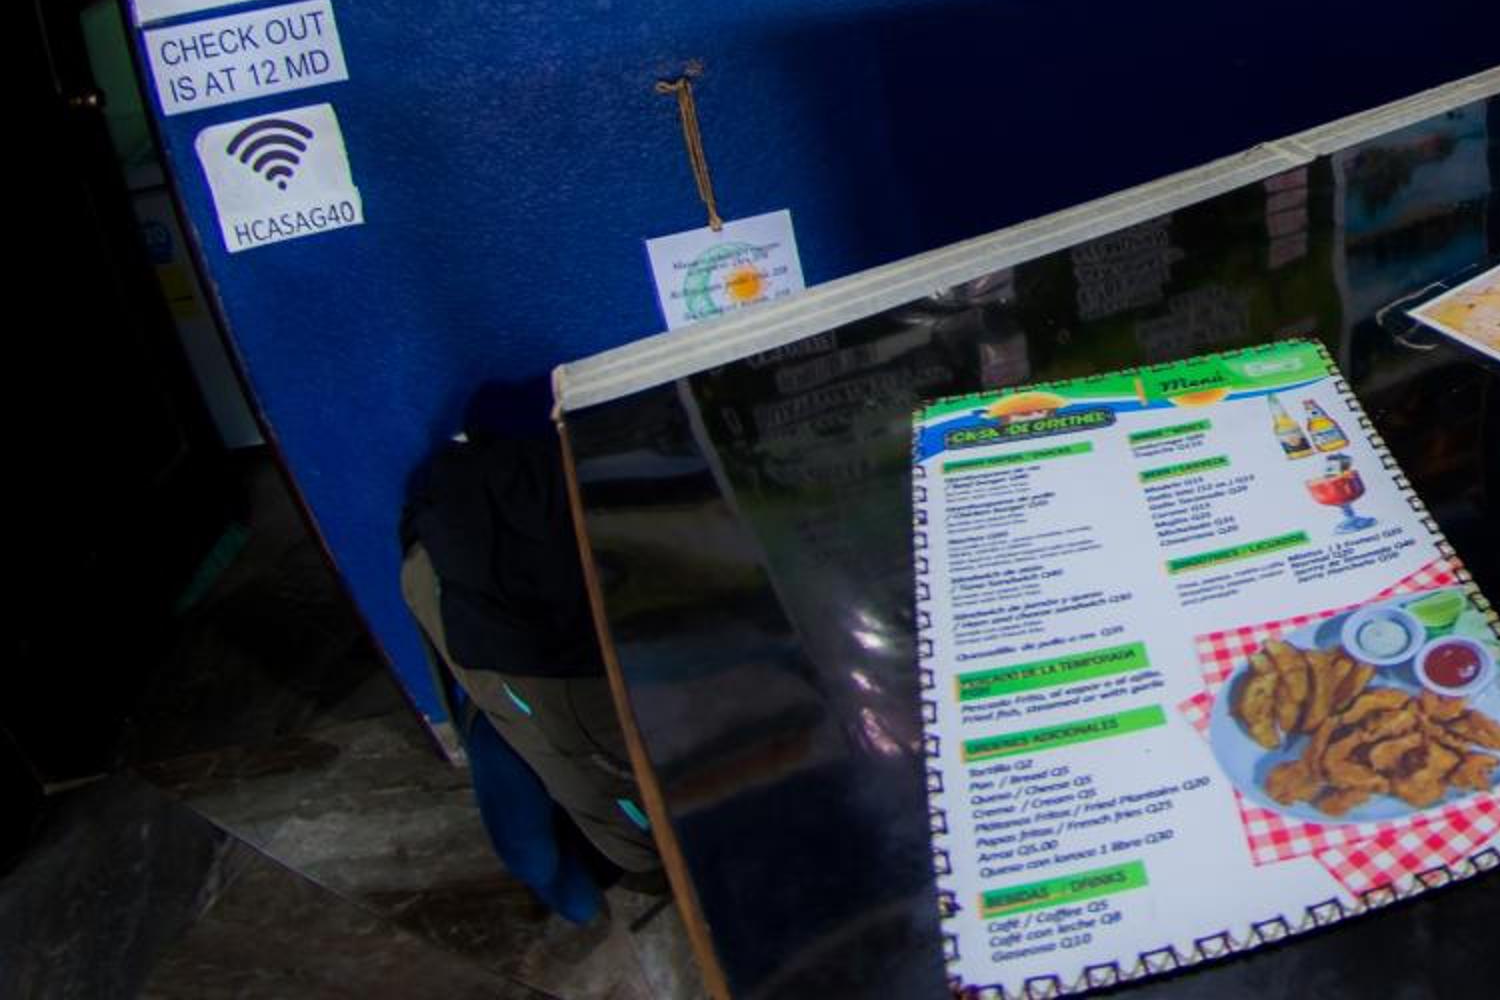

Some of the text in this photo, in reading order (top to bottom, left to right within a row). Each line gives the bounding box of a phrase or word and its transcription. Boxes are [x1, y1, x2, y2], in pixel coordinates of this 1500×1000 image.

[160, 11, 325, 67] CHECK OUT
[168, 49, 331, 103] IS AT 12 MD
[234, 200, 357, 247] HCASAG40
[1010, 770, 1049, 785] Bread
[970, 791, 1013, 807] Queso
[1025, 780, 1071, 797] Cheese
[1031, 793, 1076, 810] Cream
[980, 861, 1025, 879] Queso
